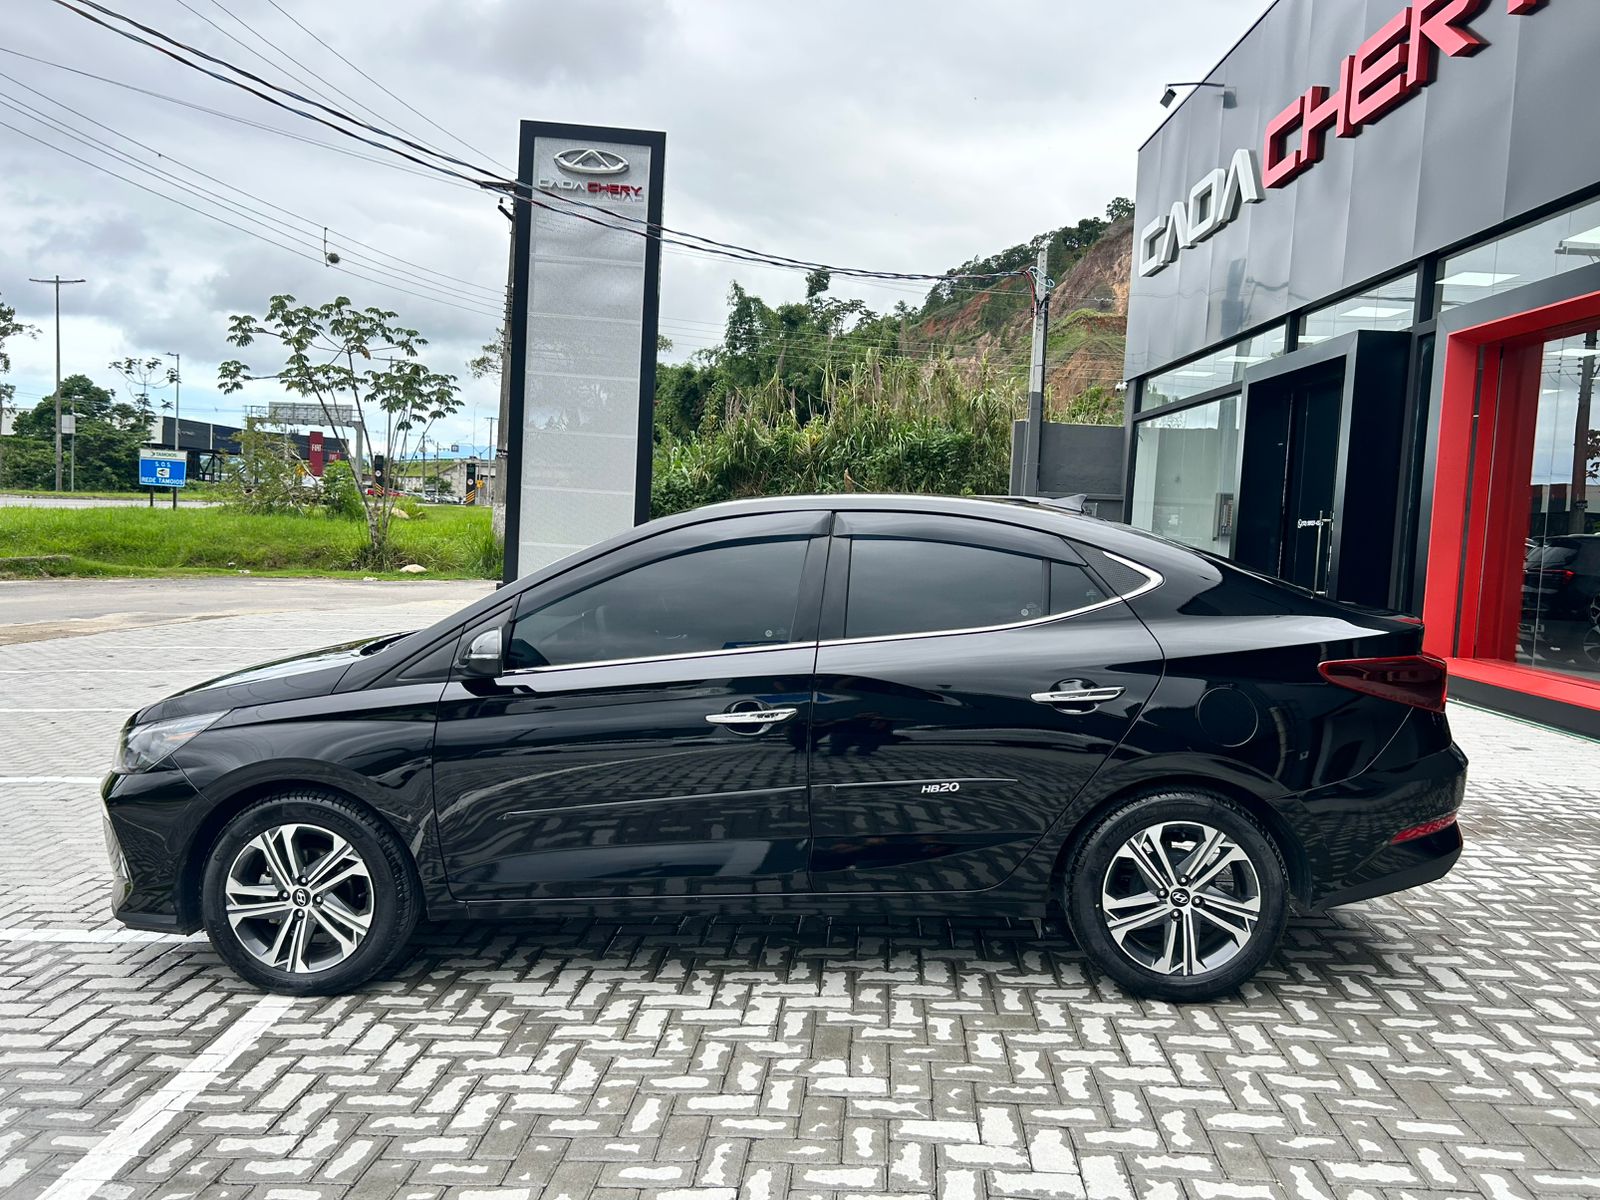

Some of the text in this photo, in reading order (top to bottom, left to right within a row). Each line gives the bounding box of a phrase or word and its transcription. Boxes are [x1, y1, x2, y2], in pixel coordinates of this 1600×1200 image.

[1262, 0, 1549, 189] CHER
[587, 183, 643, 197] CHERY
[158, 477, 184, 485] TAMOIOS
[920, 782, 960, 794] HB20
